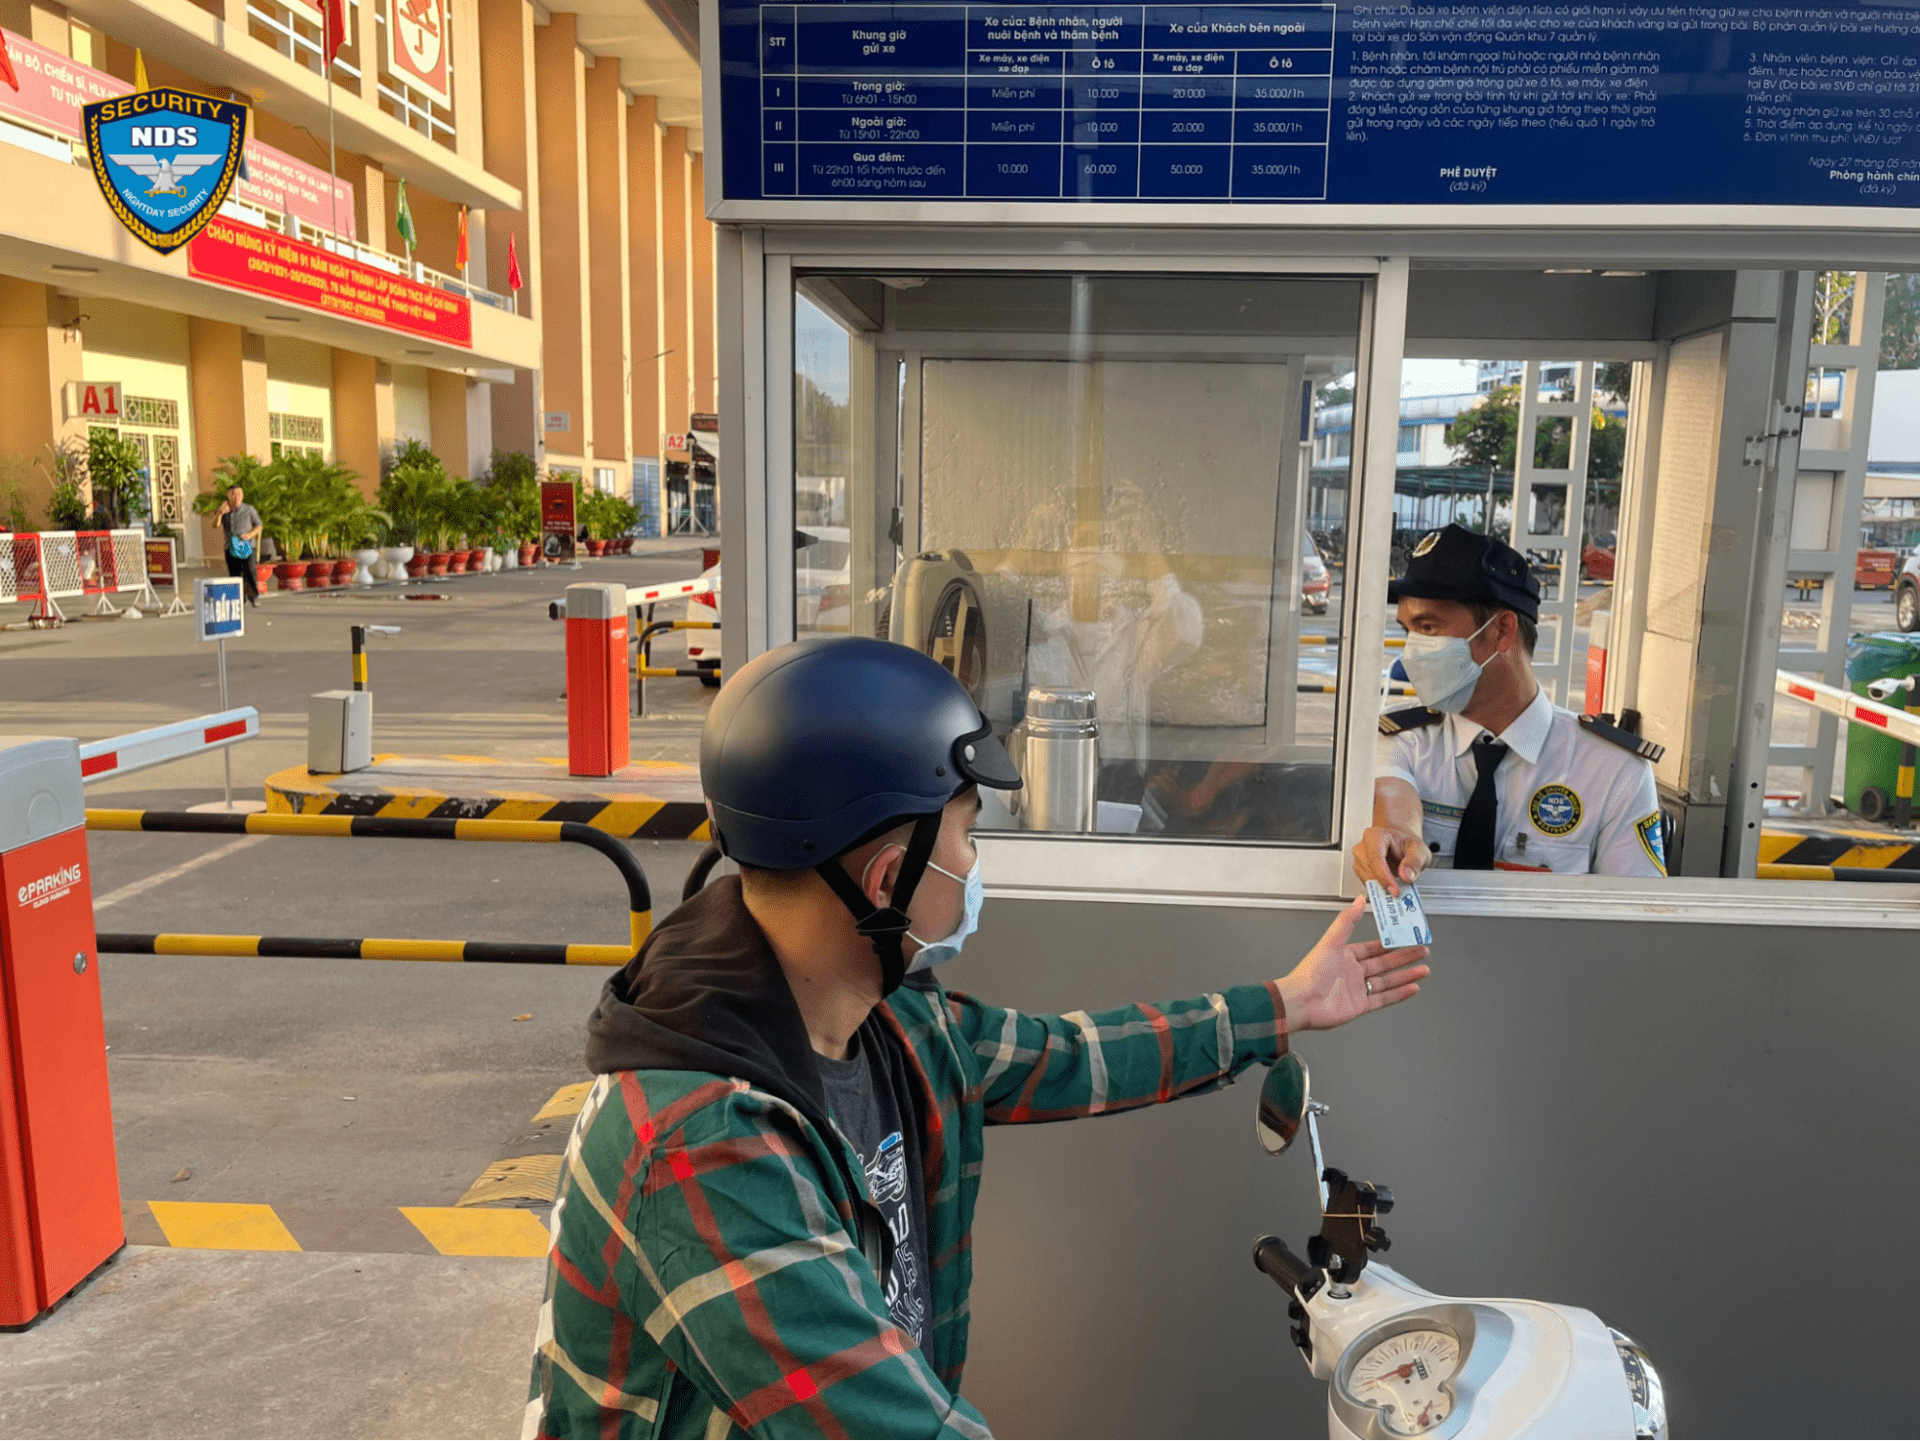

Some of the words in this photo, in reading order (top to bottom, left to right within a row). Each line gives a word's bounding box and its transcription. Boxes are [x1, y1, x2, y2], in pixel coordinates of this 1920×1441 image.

[984, 17, 999, 26] Xe
[1002, 15, 1026, 26] của:
[1029, 16, 1055, 29] Bệnh
[1058, 16, 1089, 28] nhân,
[1092, 16, 1123, 29] người
[1170, 23, 1184, 33] Xe
[1187, 22, 1208, 33] của
[1211, 23, 1246, 32] Khách
[1249, 23, 1270, 32] bên
[1273, 23, 1305, 35] ngoài
[852, 30, 885, 42] Khung
[888, 30, 906, 43] giờ
[988, 30, 1011, 39] nuôi
[1014, 30, 1041, 42] bệnh
[1044, 29, 1058, 39] và
[1061, 30, 1088, 39] thăm
[1091, 30, 1119, 42] bệnh
[1387, 34, 1399, 42] xe
[1402, 32, 1416, 42] do
[1419, 32, 1438, 42] Sân
[1441, 33, 1461, 44] vận
[1464, 31, 1493, 44] động
[1495, 32, 1525, 43] Quân
[1528, 32, 1547, 42] khu
[1550, 32, 1555, 42] 7
[1558, 32, 1585, 44] quản
[770, 37, 786, 47] STT
[5, 44, 23, 64] ÁN
[863, 43, 880, 55] gửi
[882, 45, 895, 53] xe
[979, 54, 991, 62] Xe
[993, 54, 1014, 64] máy,
[1030, 54, 1050, 64] điện
[1092, 57, 1101, 69] Ô
[1104, 58, 1115, 69] tô
[1152, 53, 1164, 62] Xe
[1166, 53, 1188, 64] máy,
[1204, 53, 1224, 64] điện
[1269, 56, 1279, 68] Ô
[1281, 58, 1292, 68] tô
[1011, 64, 1029, 75] đạp
[1185, 64, 1203, 74] đạp
[852, 82, 882, 93] Trong
[885, 81, 905, 93] giờ:
[842, 94, 853, 104] Từ
[854, 94, 878, 104] 6h01
[888, 94, 917, 104] 15h00
[992, 88, 1017, 98] Miễn
[1019, 88, 1036, 100] phí
[1088, 89, 1119, 99] 10.000
[1173, 89, 1206, 99] 20.000
[1254, 89, 1304, 100] 35.000/1h
[1745, 106, 1753, 114] 4.
[1757, 106, 1791, 117] Không
[1793, 106, 1820, 117] nhận
[1841, 109, 1853, 117] xe
[1856, 108, 1875, 117] trên
[1878, 108, 1890, 118] 30
[775, 122, 782, 131] II
[852, 117, 884, 129] Ngoài
[886, 117, 906, 129] giờ:
[991, 121, 1016, 132] Miễn
[1018, 122, 1035, 133] phí
[1087, 122, 1118, 132] 10.000
[1172, 123, 1205, 132] 20.000
[1253, 123, 1302, 133] 35.000/1h
[839, 130, 851, 139] Từ
[853, 130, 881, 139] 15h01
[890, 130, 920, 139] 22h00
[1755, 132, 1776, 141] Đơn
[1790, 132, 1809, 141] tính
[1812, 133, 1828, 142] thu
[1831, 133, 1849, 144] phí:
[1882, 135, 1902, 145] lượt
[853, 153, 875, 163] Qua
[878, 152, 905, 162] đêm:
[1808, 156, 1836, 168] Ngày
[1839, 157, 1852, 167] 27
[1854, 157, 1884, 169] tháng
[1886, 158, 1899, 168] 05
[774, 163, 784, 172] III
[812, 164, 824, 174] Từ
[826, 164, 854, 174] 22h01
[856, 164, 870, 174] tối
[872, 164, 895, 174] hôm
[897, 164, 922, 175] trước
[925, 163, 945, 175] đến
[997, 164, 1029, 174] 10.000
[1084, 164, 1116, 174] 60.000
[1170, 165, 1203, 174] 50.000
[1251, 165, 1300, 175] 35.000/1h
[1440, 166, 1461, 178] PHÊ
[1464, 166, 1498, 180] DUYỆT
[1829, 170, 1864, 182] Phòng
[1867, 171, 1894, 181] hành
[831, 178, 855, 187] 6h00
[857, 178, 881, 189] sáng
[884, 178, 906, 188] hôm
[908, 179, 926, 187] sau
[83, 386, 118, 414] A1
[668, 436, 684, 448] A2
[1548, 797, 1564, 805] NDS
